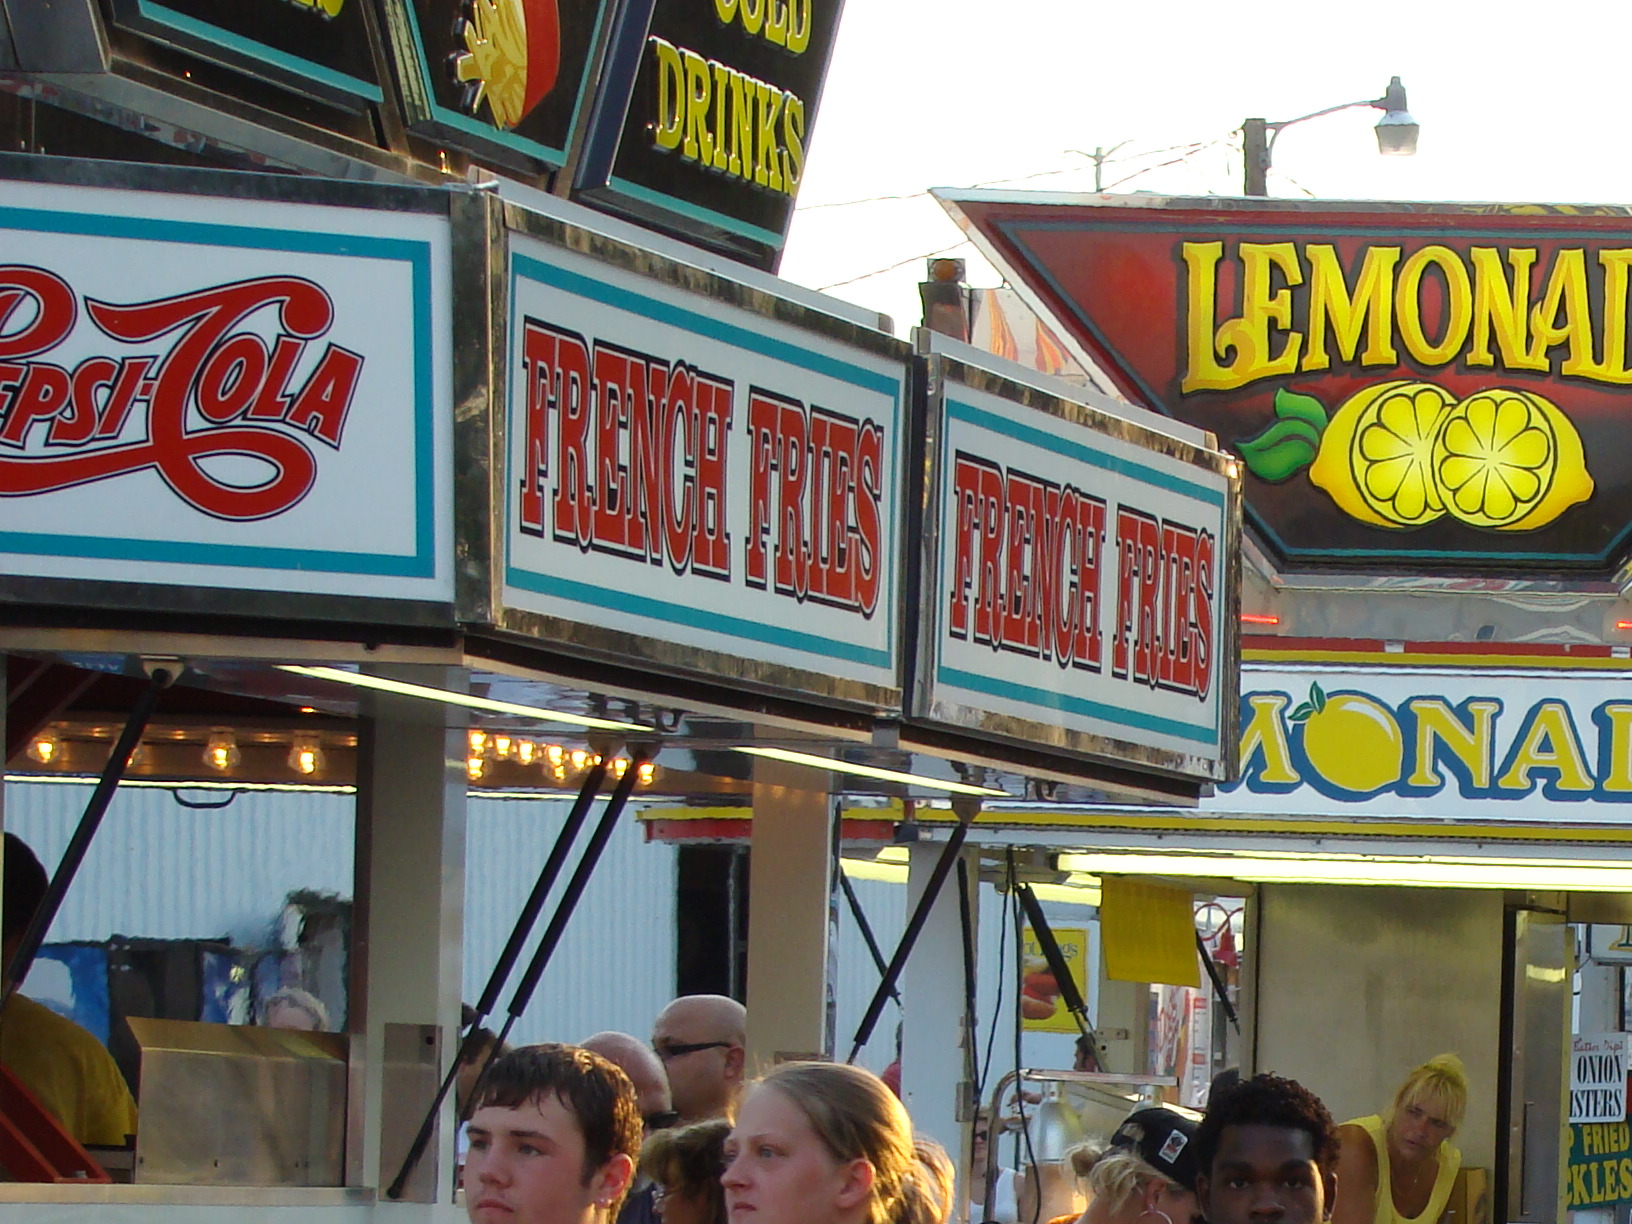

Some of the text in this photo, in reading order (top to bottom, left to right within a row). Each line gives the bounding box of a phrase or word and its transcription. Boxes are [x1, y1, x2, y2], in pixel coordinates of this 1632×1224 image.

[650, 35, 804, 197] DRINKS
[520, 315, 883, 620] FRENCH FRIES
[949, 449, 1215, 703] FRENCH FRIES
[1577, 1054, 1623, 1085] ONION
[1583, 1123, 1630, 1156] FRIED
